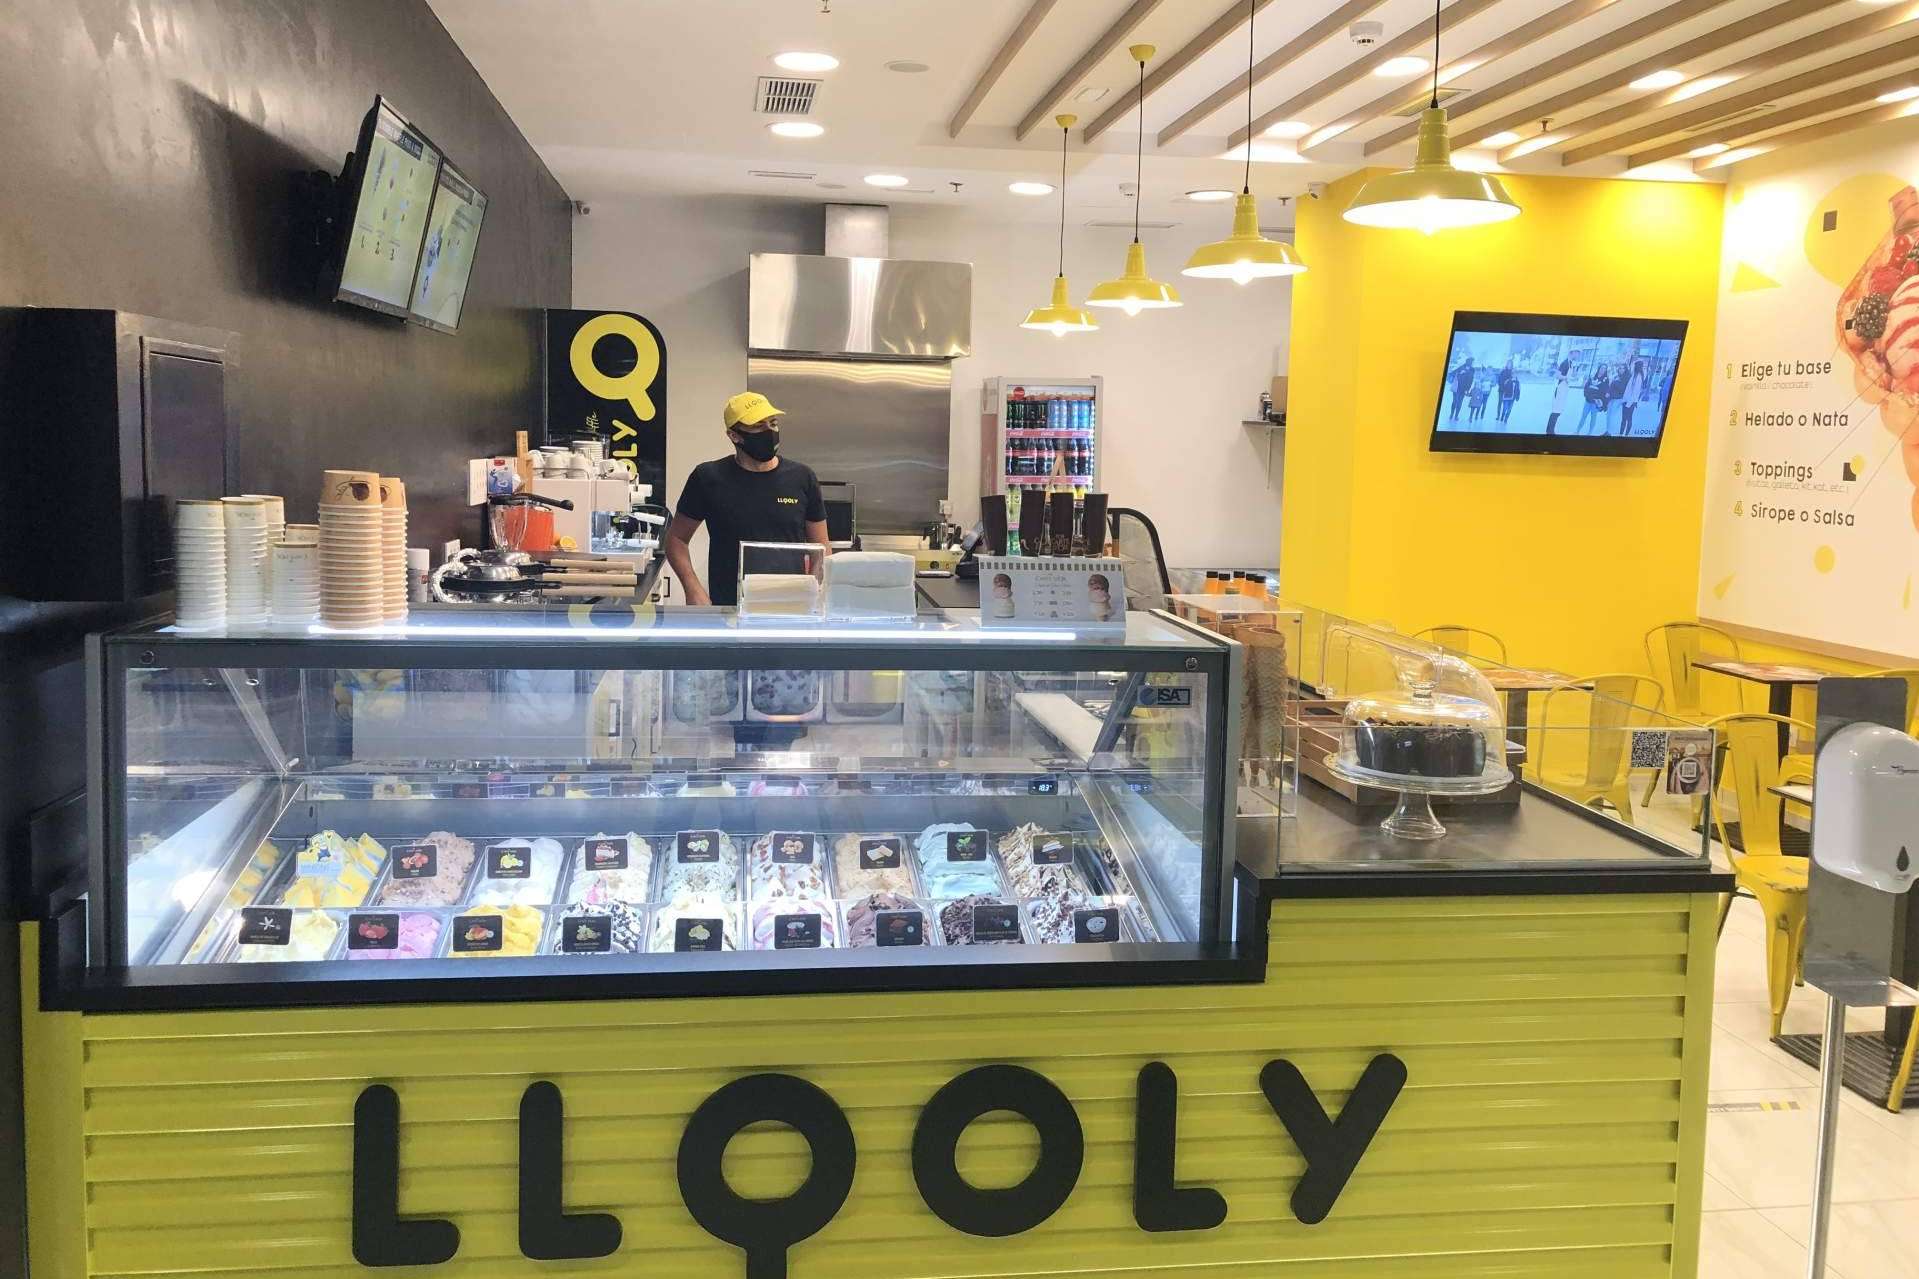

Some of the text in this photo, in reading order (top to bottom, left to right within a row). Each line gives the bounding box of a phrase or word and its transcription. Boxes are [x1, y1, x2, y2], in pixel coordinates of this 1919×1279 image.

[570, 313, 660, 421] Q
[1741, 361, 1774, 381] Elige
[1777, 360, 1791, 376] tu
[1795, 359, 1832, 376] base
[1745, 411, 1794, 427] Helado
[1798, 415, 1807, 427] o
[1812, 411, 1848, 427] Nata
[1750, 460, 1813, 482] Toppings
[1734, 500, 1855, 527] 4 Sirope o Salsa
